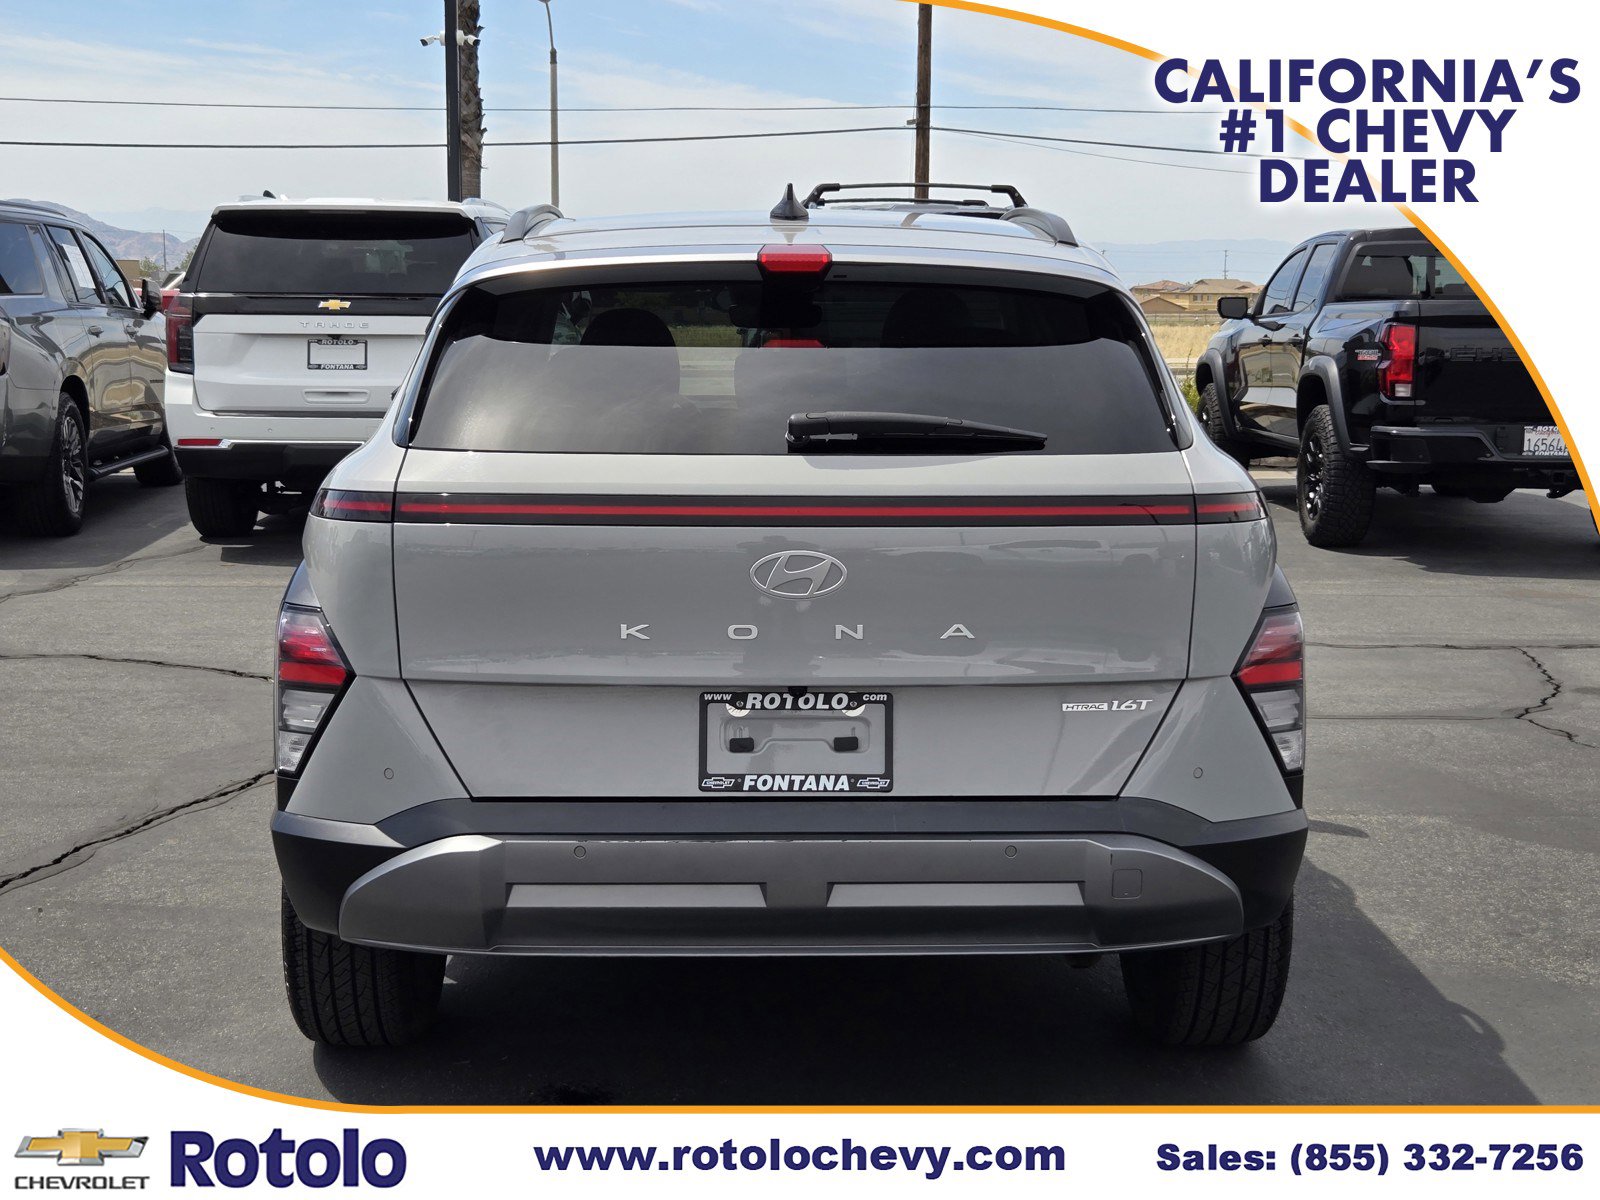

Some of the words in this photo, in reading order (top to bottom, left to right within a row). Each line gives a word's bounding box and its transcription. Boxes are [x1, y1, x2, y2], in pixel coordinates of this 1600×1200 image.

[619, 622, 976, 641] KONA
[704, 693, 732, 701] www
[745, 693, 849, 709] ROTOLO
[863, 693, 887, 701] com
[1064, 703, 1106, 711] HTRAC
[743, 774, 850, 791] FONTANA
